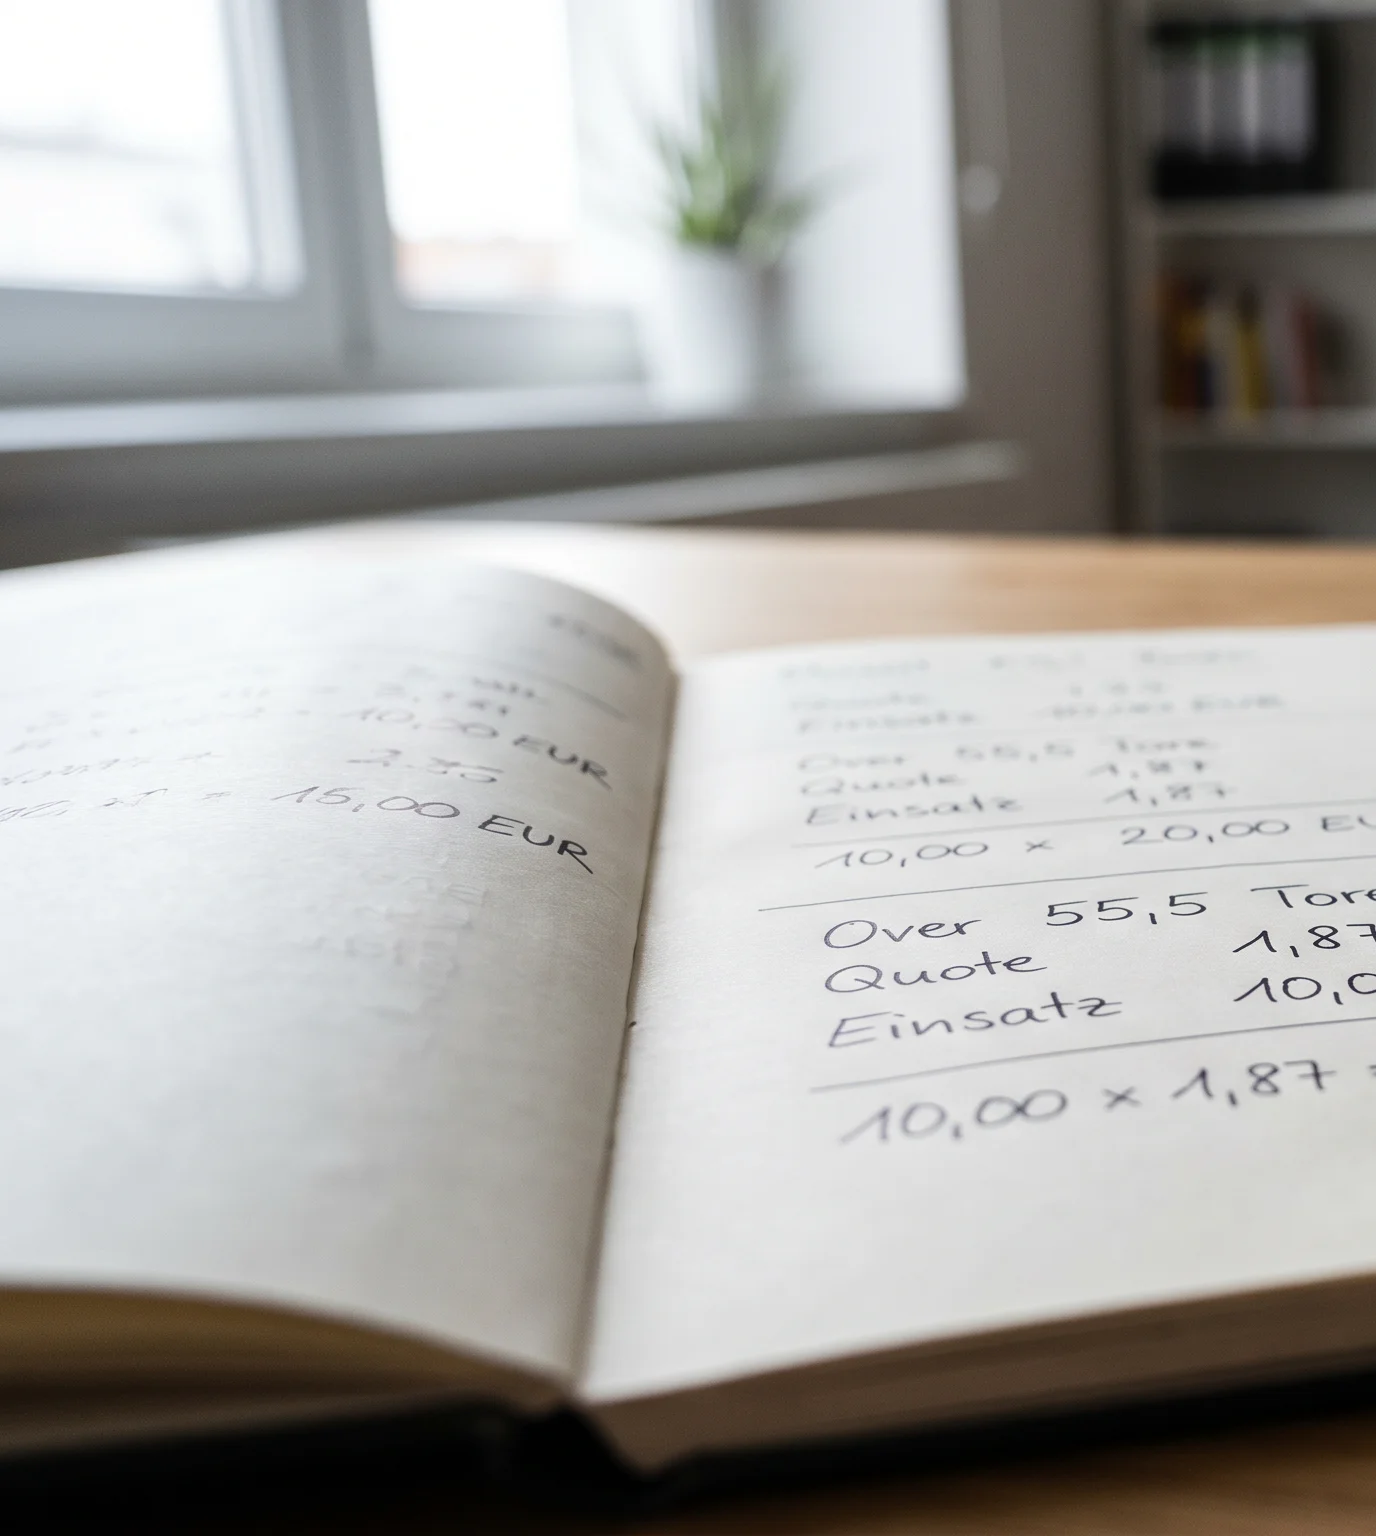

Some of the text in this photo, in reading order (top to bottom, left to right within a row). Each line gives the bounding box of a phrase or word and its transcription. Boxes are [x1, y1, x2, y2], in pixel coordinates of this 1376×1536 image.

[513, 734, 612, 791] EUR
[801, 772, 964, 797] Quote
[270, 786, 461, 818] 15,00
[477, 814, 594, 875] EUR
[805, 794, 1023, 824] Einsatz
[813, 840, 988, 868] 10,00
[1120, 818, 1290, 844] 20,00
[823, 919, 984, 949] Over
[1046, 892, 1208, 927] 55,5
[824, 951, 1048, 993] Quote
[827, 991, 1123, 1048] Einsatz
[839, 1088, 1068, 1144] 10,00
[1171, 1059, 1336, 1107] 1,87
